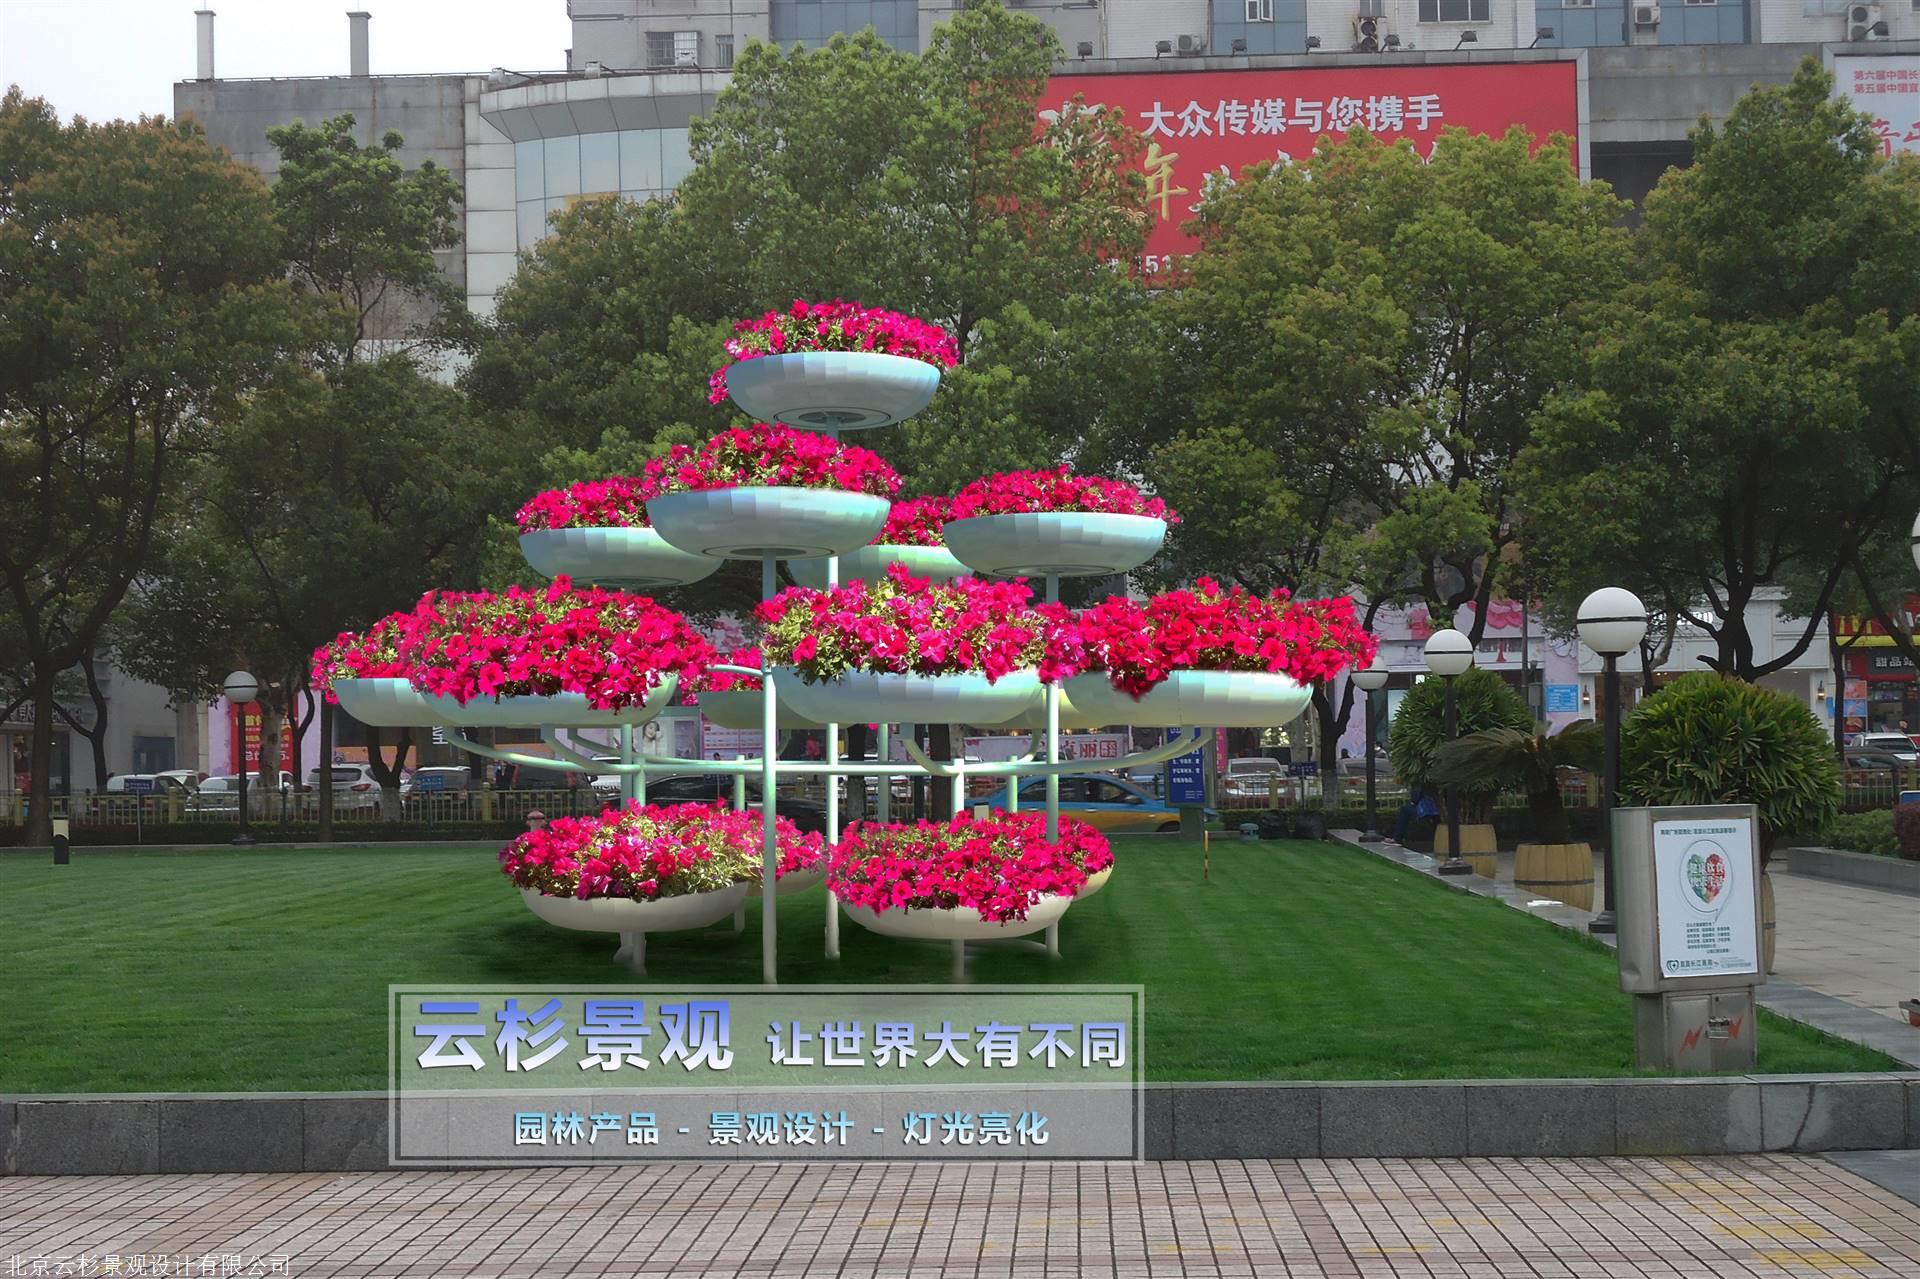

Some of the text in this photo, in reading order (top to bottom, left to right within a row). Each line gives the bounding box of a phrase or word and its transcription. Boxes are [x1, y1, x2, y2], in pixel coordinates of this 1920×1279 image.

[1140, 94, 1444, 138] 大众传媒与您携手
